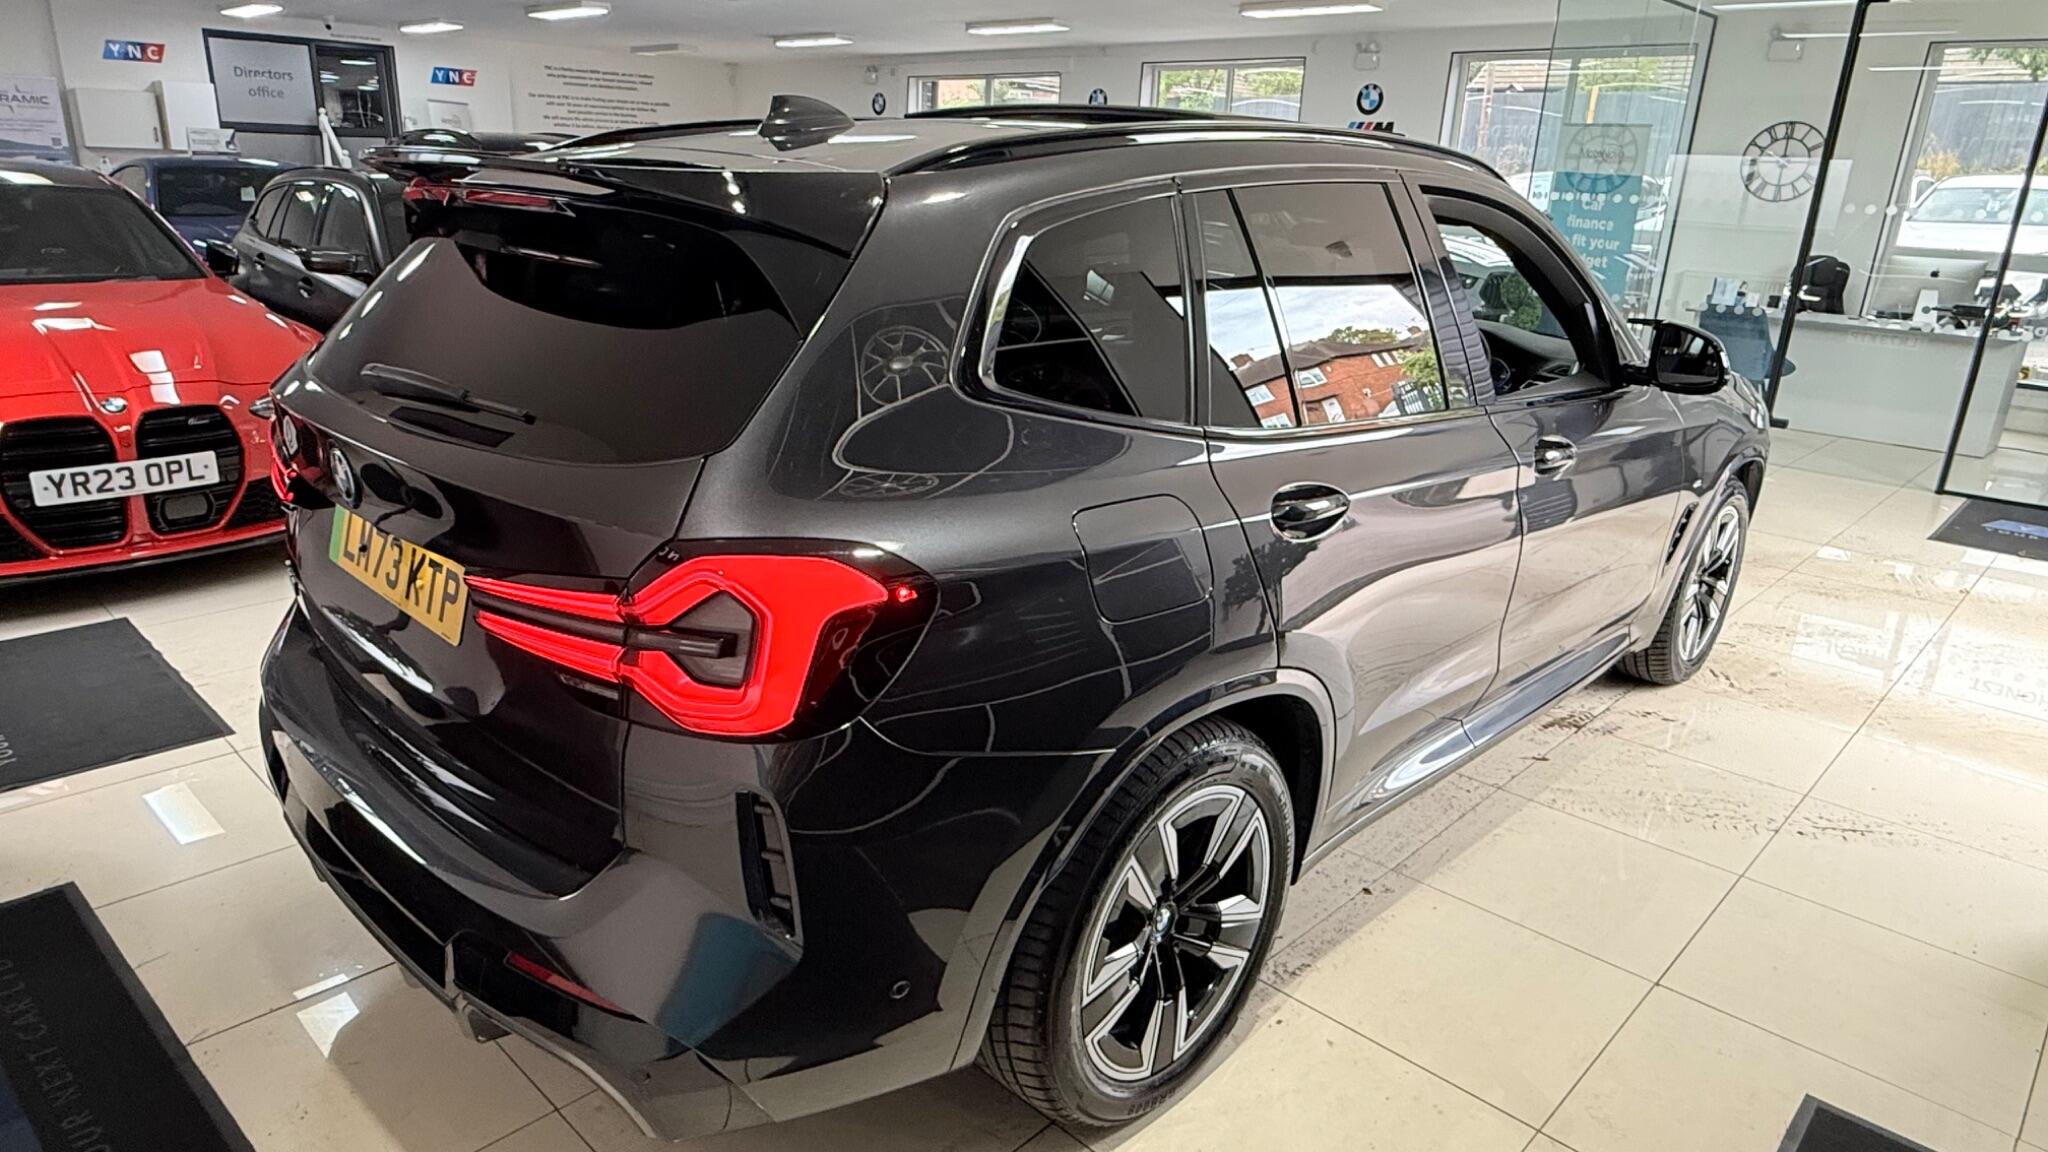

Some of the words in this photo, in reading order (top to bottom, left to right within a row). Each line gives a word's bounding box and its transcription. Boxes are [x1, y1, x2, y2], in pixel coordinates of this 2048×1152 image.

[107, 42, 160, 60] YNC
[233, 66, 294, 81] Directors
[435, 69, 473, 84] YNC
[248, 86, 285, 99] office
[1566, 213, 1614, 231] finance
[1572, 233, 1587, 247] fit
[1589, 238, 1620, 251] your
[46, 466, 136, 498] YR23
[145, 458, 205, 486] OPL
[405, 547, 460, 622] KTP
